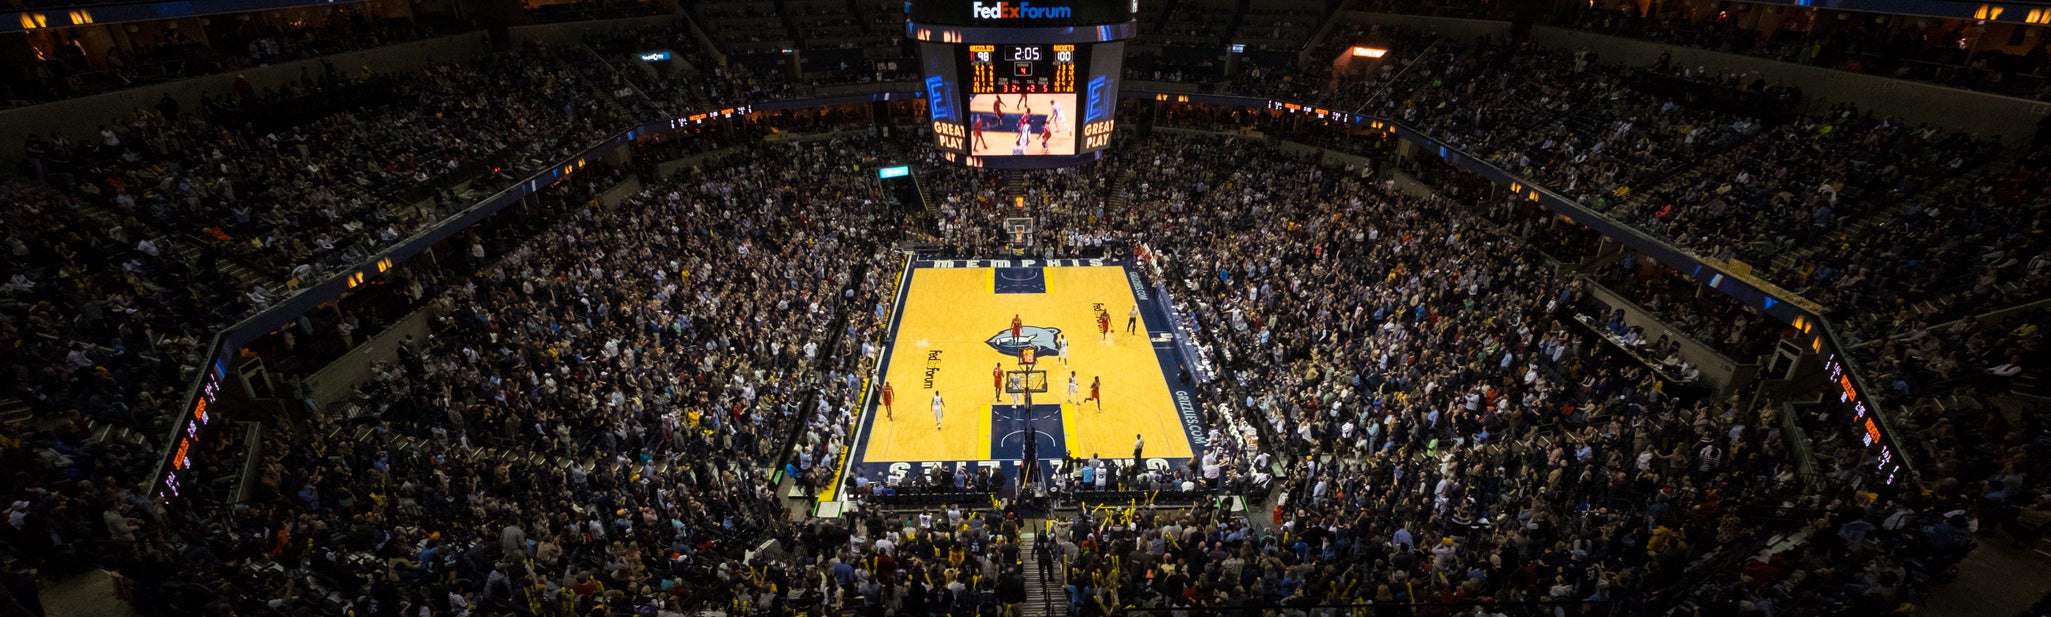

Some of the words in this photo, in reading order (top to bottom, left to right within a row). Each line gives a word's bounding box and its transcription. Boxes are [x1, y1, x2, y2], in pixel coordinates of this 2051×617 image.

[973, 1, 1071, 19] FedExForum
[977, 52, 990, 61] 98
[1014, 47, 1039, 60] 2:05
[1057, 51, 1071, 61] 100
[934, 121, 966, 138] GREAT
[1084, 119, 1114, 136] GREAT
[939, 134, 963, 150] PLAY
[1085, 133, 1109, 150] PLAY
[933, 258, 1104, 269] MEMPHIS
[1175, 390, 1208, 445] GRIZZLIES.COM
